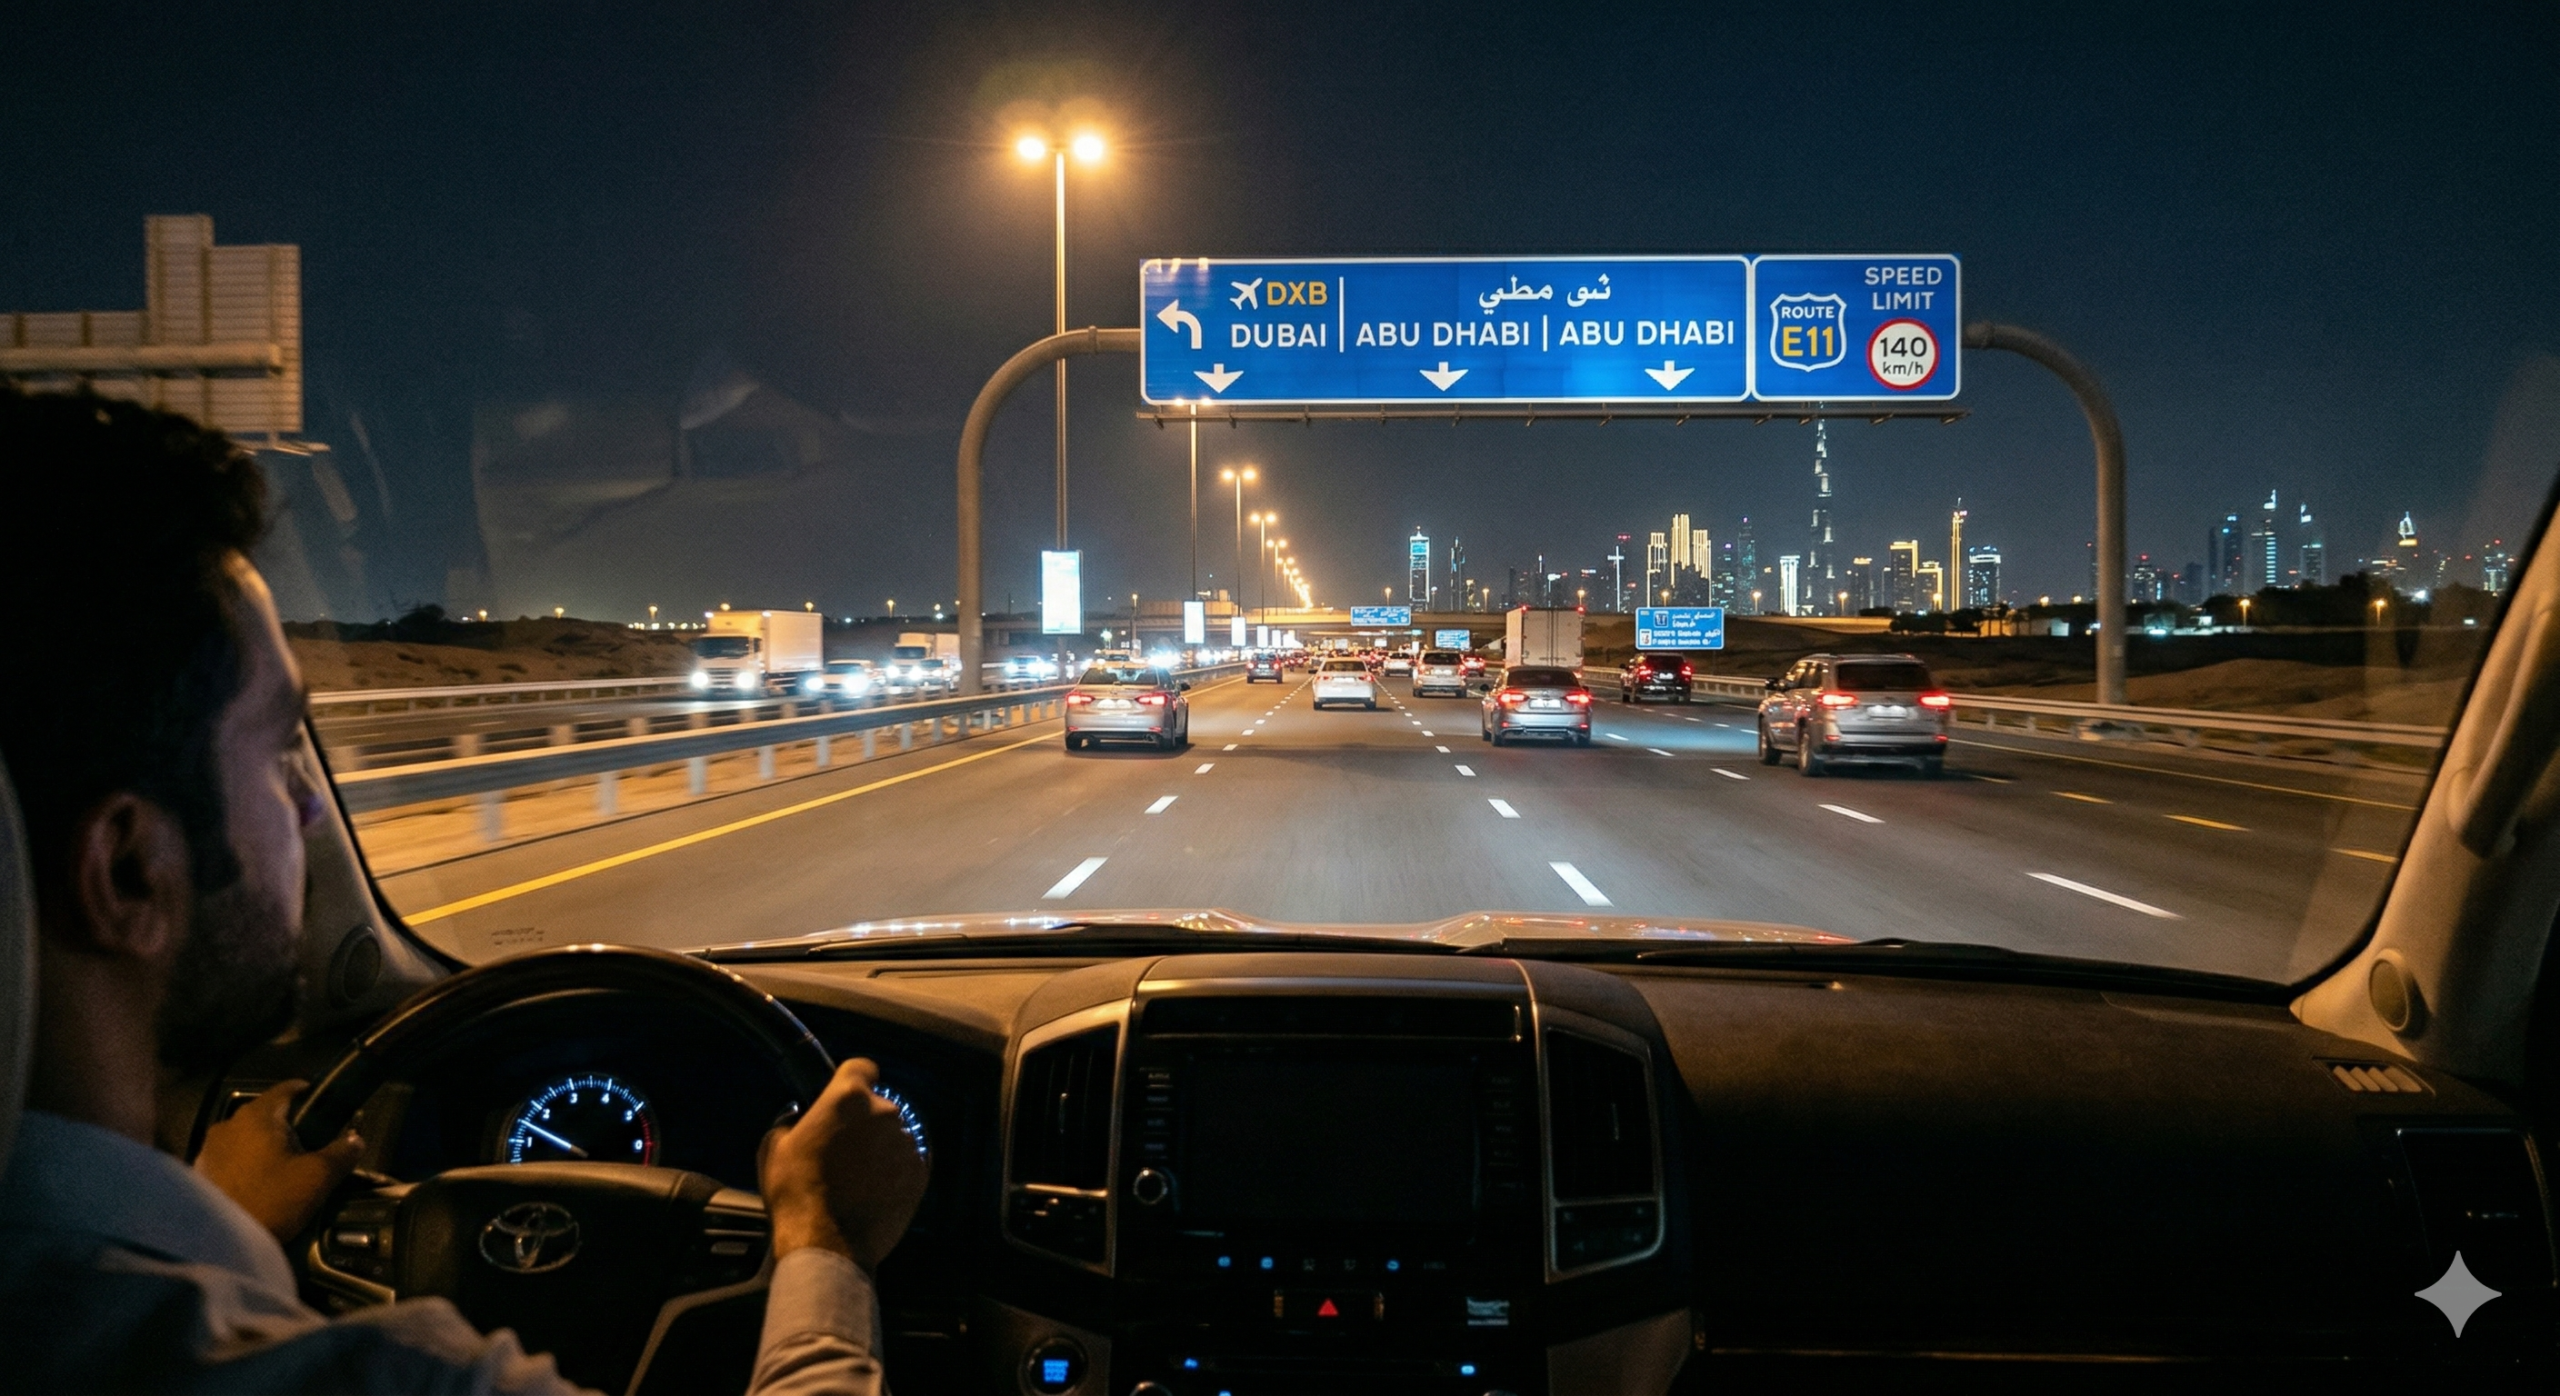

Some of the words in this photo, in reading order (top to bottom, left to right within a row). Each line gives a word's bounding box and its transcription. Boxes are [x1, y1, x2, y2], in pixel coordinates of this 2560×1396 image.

[1865, 267, 1942, 285] SPEED
[1267, 281, 1328, 306] DXB
[1872, 291, 1935, 310] LIMIT
[1781, 306, 1835, 319] ROUTE
[1231, 323, 1327, 348] DUBAI
[1356, 322, 1420, 347] ABU
[1433, 321, 1529, 347] DHABI
[1559, 321, 1624, 346] ABU
[1637, 320, 1735, 346] DHABI
[1782, 326, 1834, 357] E11
[1880, 336, 1928, 357] 140
[1882, 361, 1924, 376] km/h
[570, 1093, 578, 1104] 3
[602, 1093, 610, 1104] 4
[543, 1109, 551, 1120] 2
